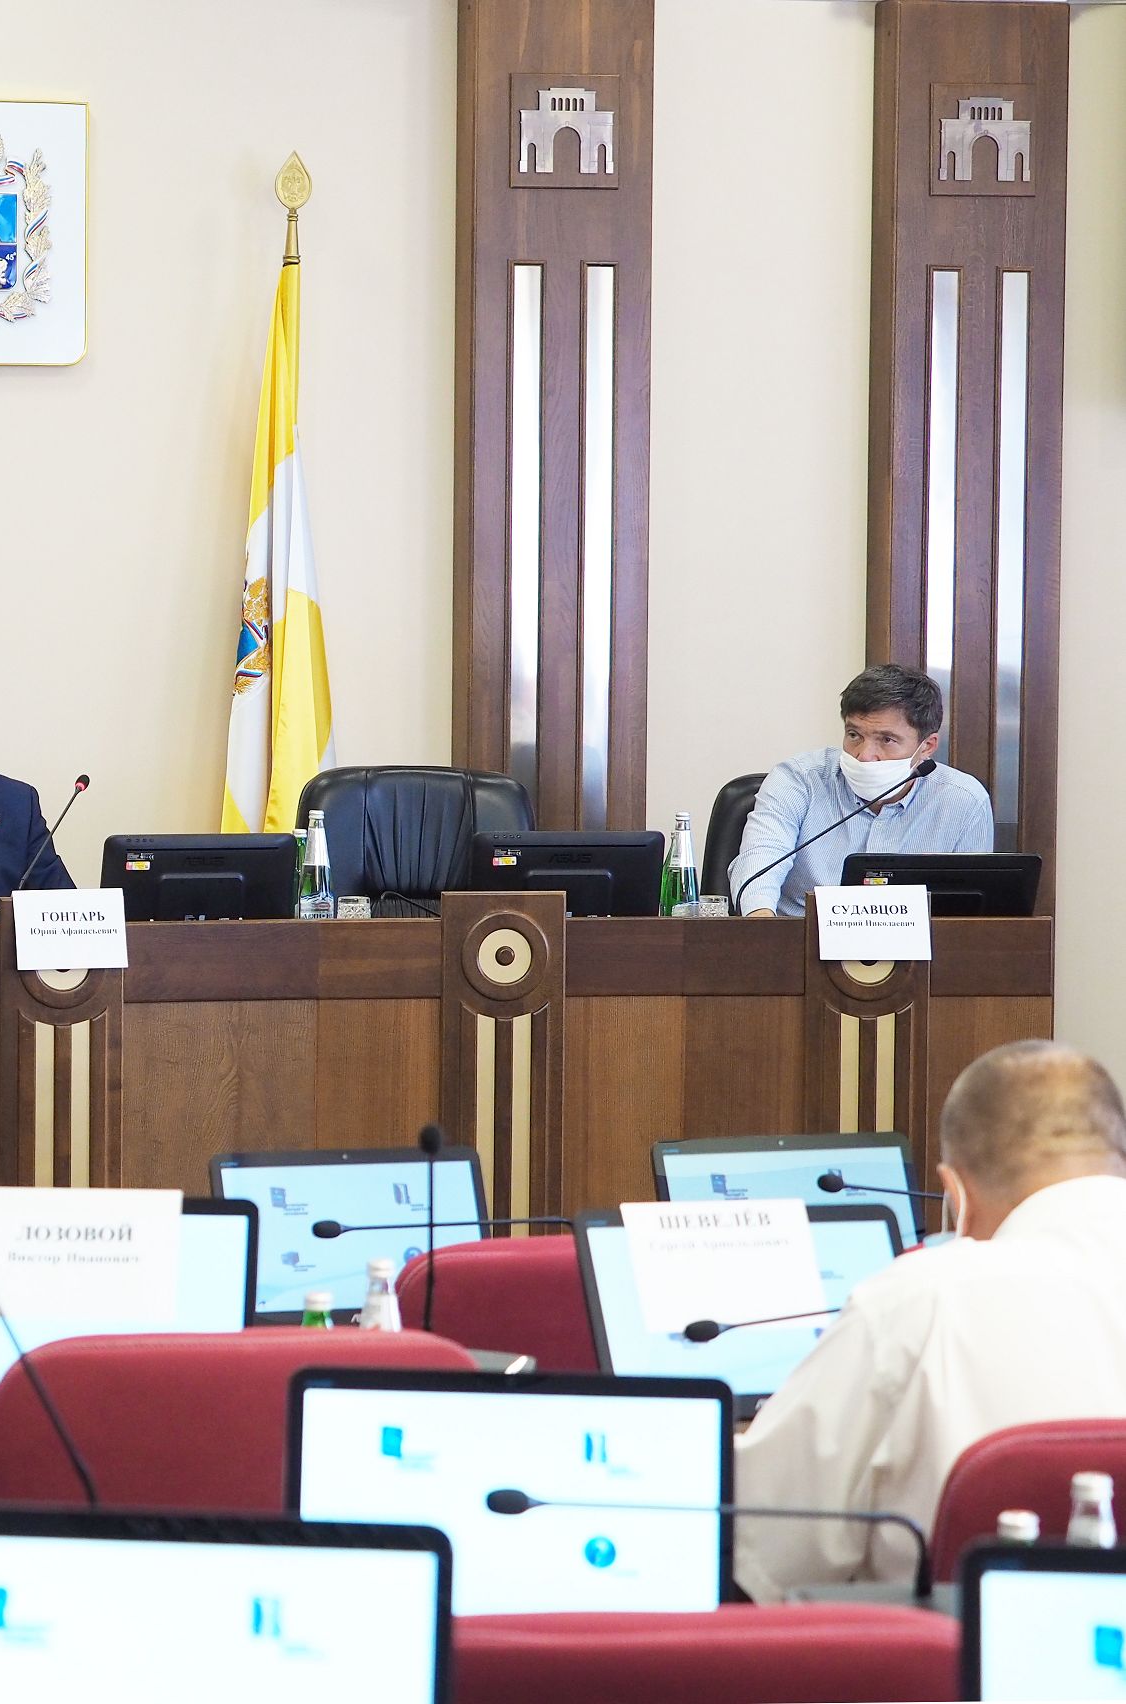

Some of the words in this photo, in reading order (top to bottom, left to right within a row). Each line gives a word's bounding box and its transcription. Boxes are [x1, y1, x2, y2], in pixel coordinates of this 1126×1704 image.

[831, 904, 908, 916] СУДАВЦОВ
[41, 911, 105, 922] ГОНТАРЬ
[826, 919, 863, 928] Дмитрий
[865, 919, 915, 927] Николаевич
[30, 927, 57, 936] Юрий
[60, 927, 118, 936] Афанасьевич
[659, 1208, 771, 1229] ШЕВЕЛЁВ
[15, 1222, 132, 1241] ЛОЗОВОЙ
[8, 1251, 61, 1264] Виктор
[67, 1251, 139, 1264] Иванович
